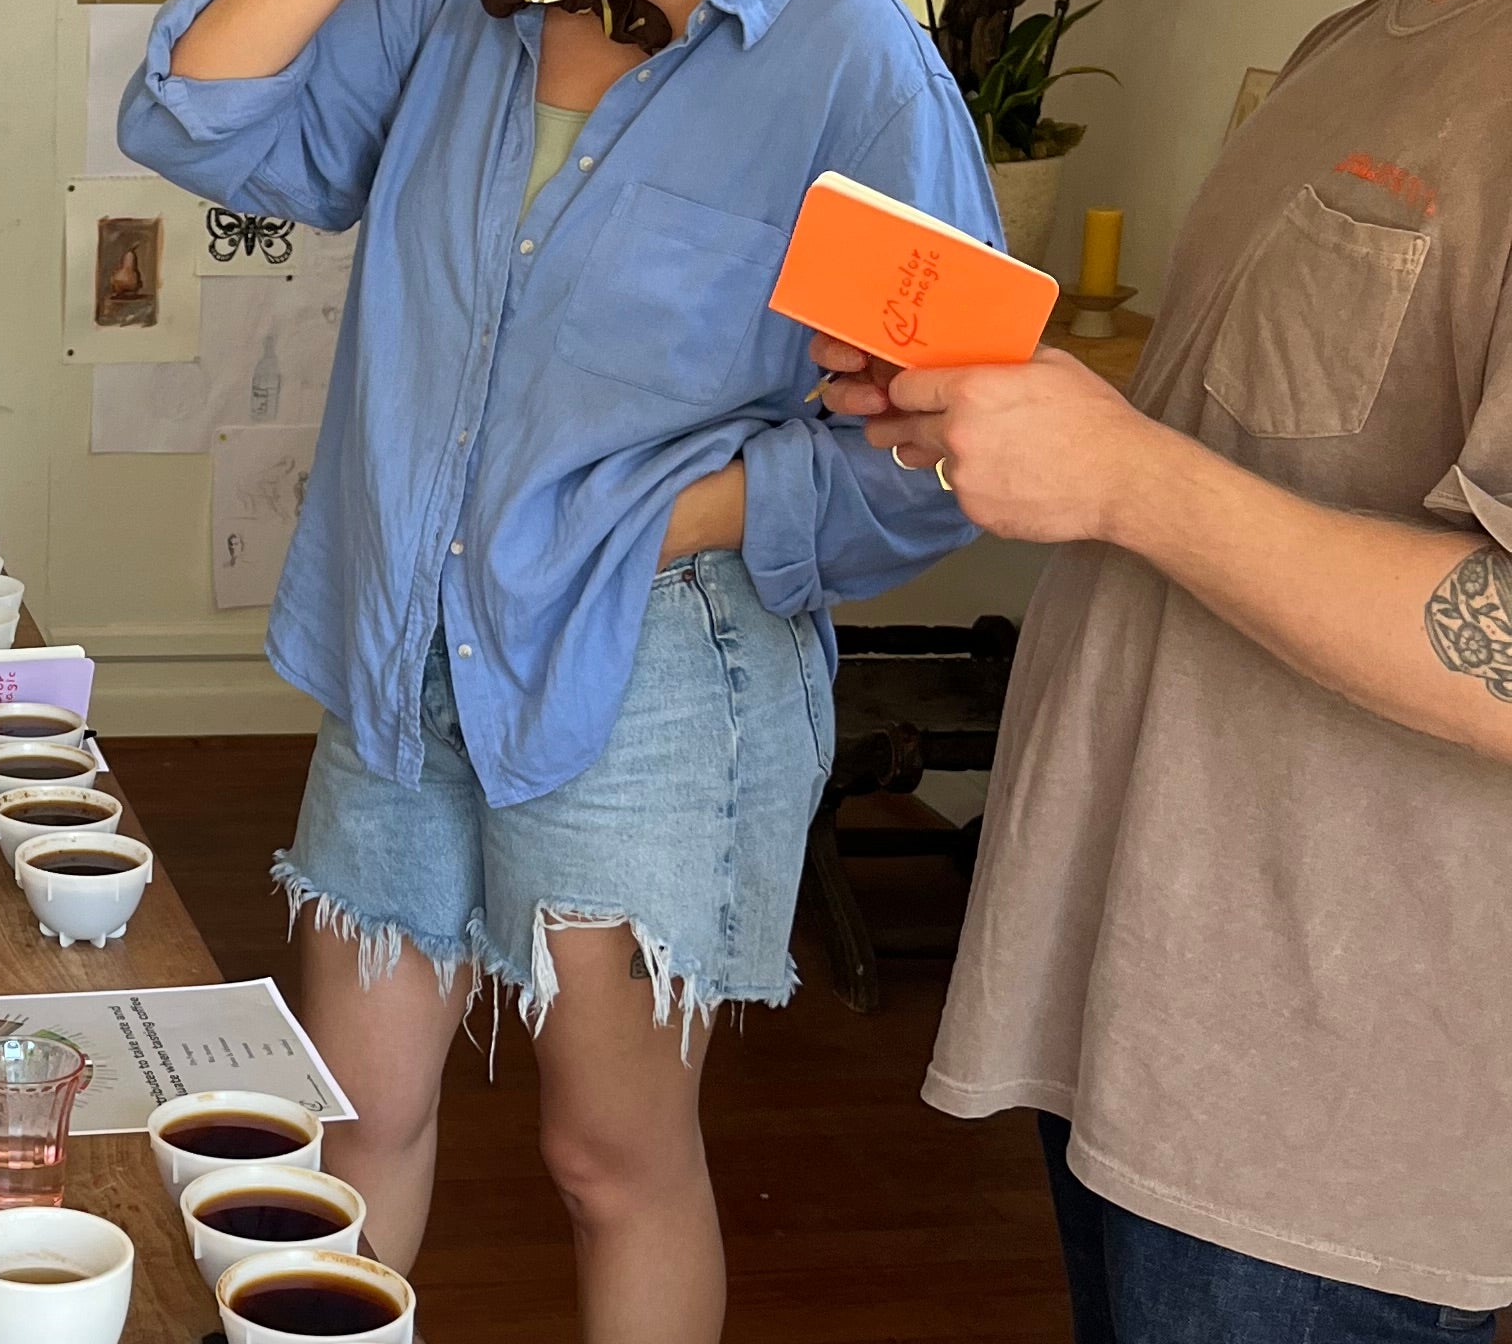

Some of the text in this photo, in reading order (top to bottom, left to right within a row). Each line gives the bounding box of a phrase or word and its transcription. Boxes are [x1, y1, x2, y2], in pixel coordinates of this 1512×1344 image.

[896, 249, 922, 297] color
[911, 250, 940, 308] magic
[5, 671, 18, 704] agic
[119, 1021, 136, 1041] note
[127, 1040, 145, 1059] take
